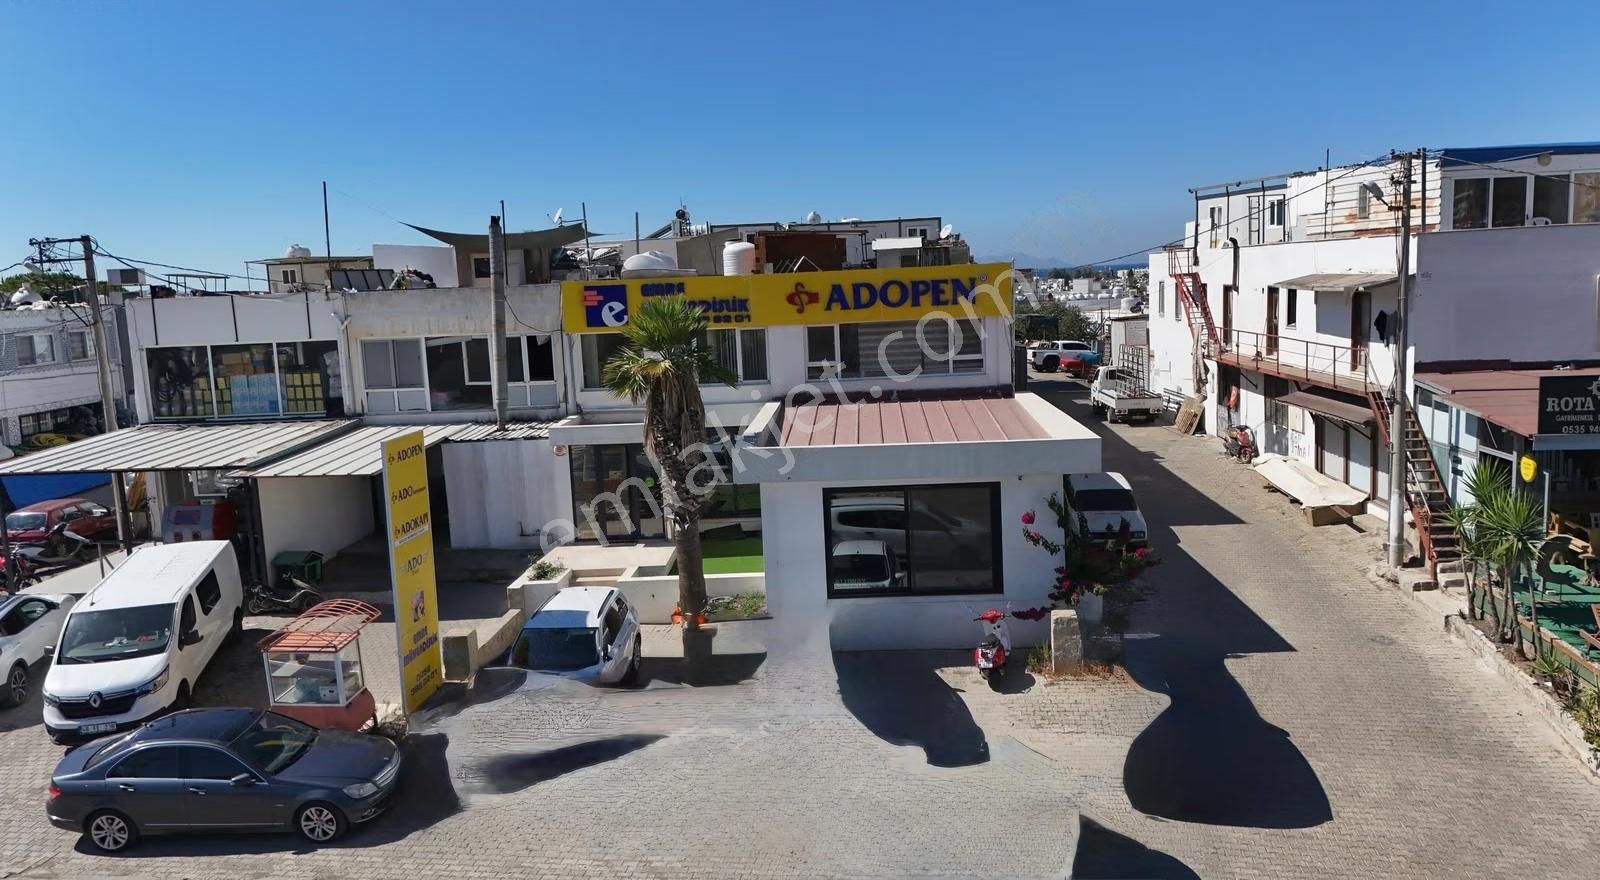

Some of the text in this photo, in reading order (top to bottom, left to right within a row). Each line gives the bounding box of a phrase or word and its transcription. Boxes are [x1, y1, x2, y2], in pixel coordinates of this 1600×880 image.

[824, 277, 977, 311] ADOPEN
[1545, 396, 1595, 412] ROTA
[1562, 425, 1585, 434] 0535
[397, 444, 423, 462] ADOPEN
[398, 486, 413, 502] ADO
[407, 554, 423, 573] ADO
